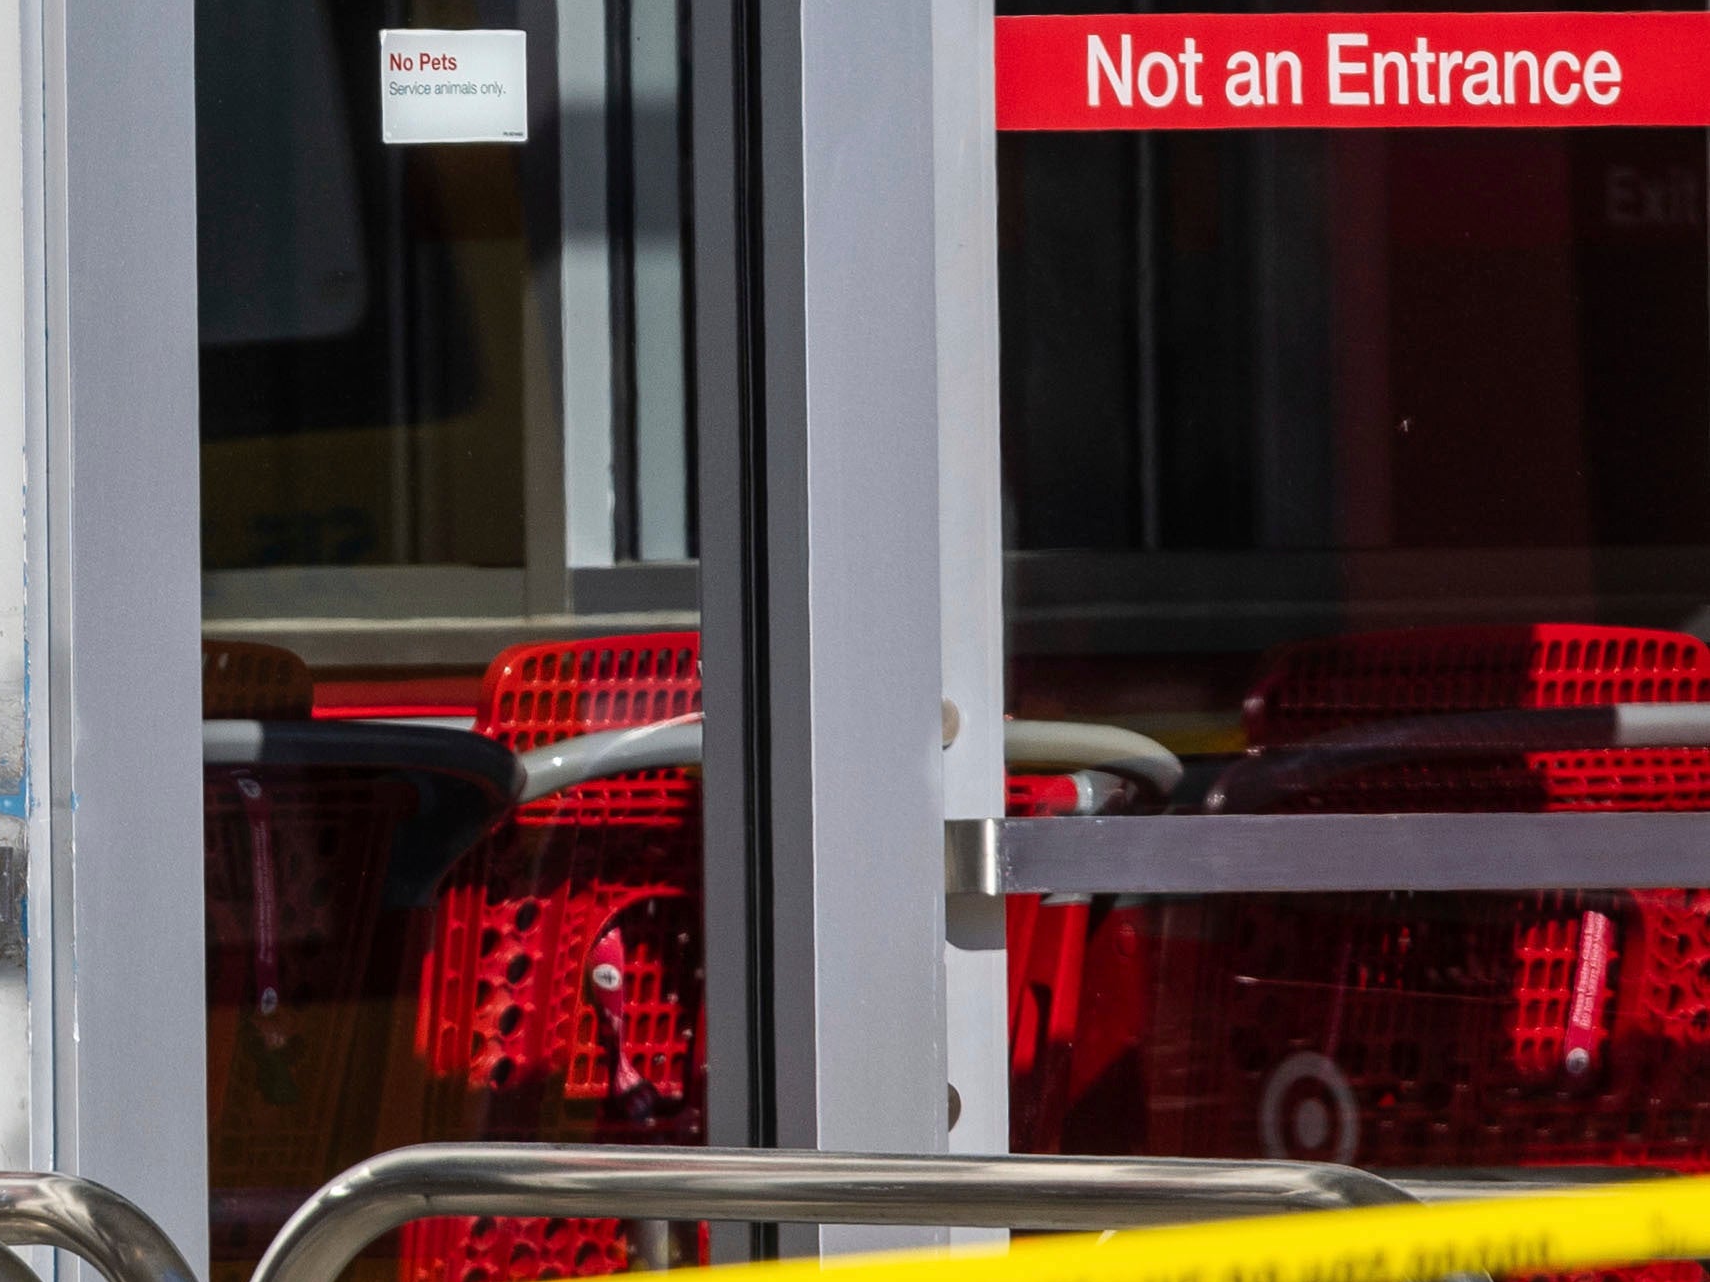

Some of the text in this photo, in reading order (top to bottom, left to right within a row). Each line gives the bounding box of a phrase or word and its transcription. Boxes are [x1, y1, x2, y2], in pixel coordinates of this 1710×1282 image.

[389, 53, 457, 71] No Pets
[1087, 33, 1622, 107] Not an Entrance
[389, 81, 507, 97] Service animals only.
